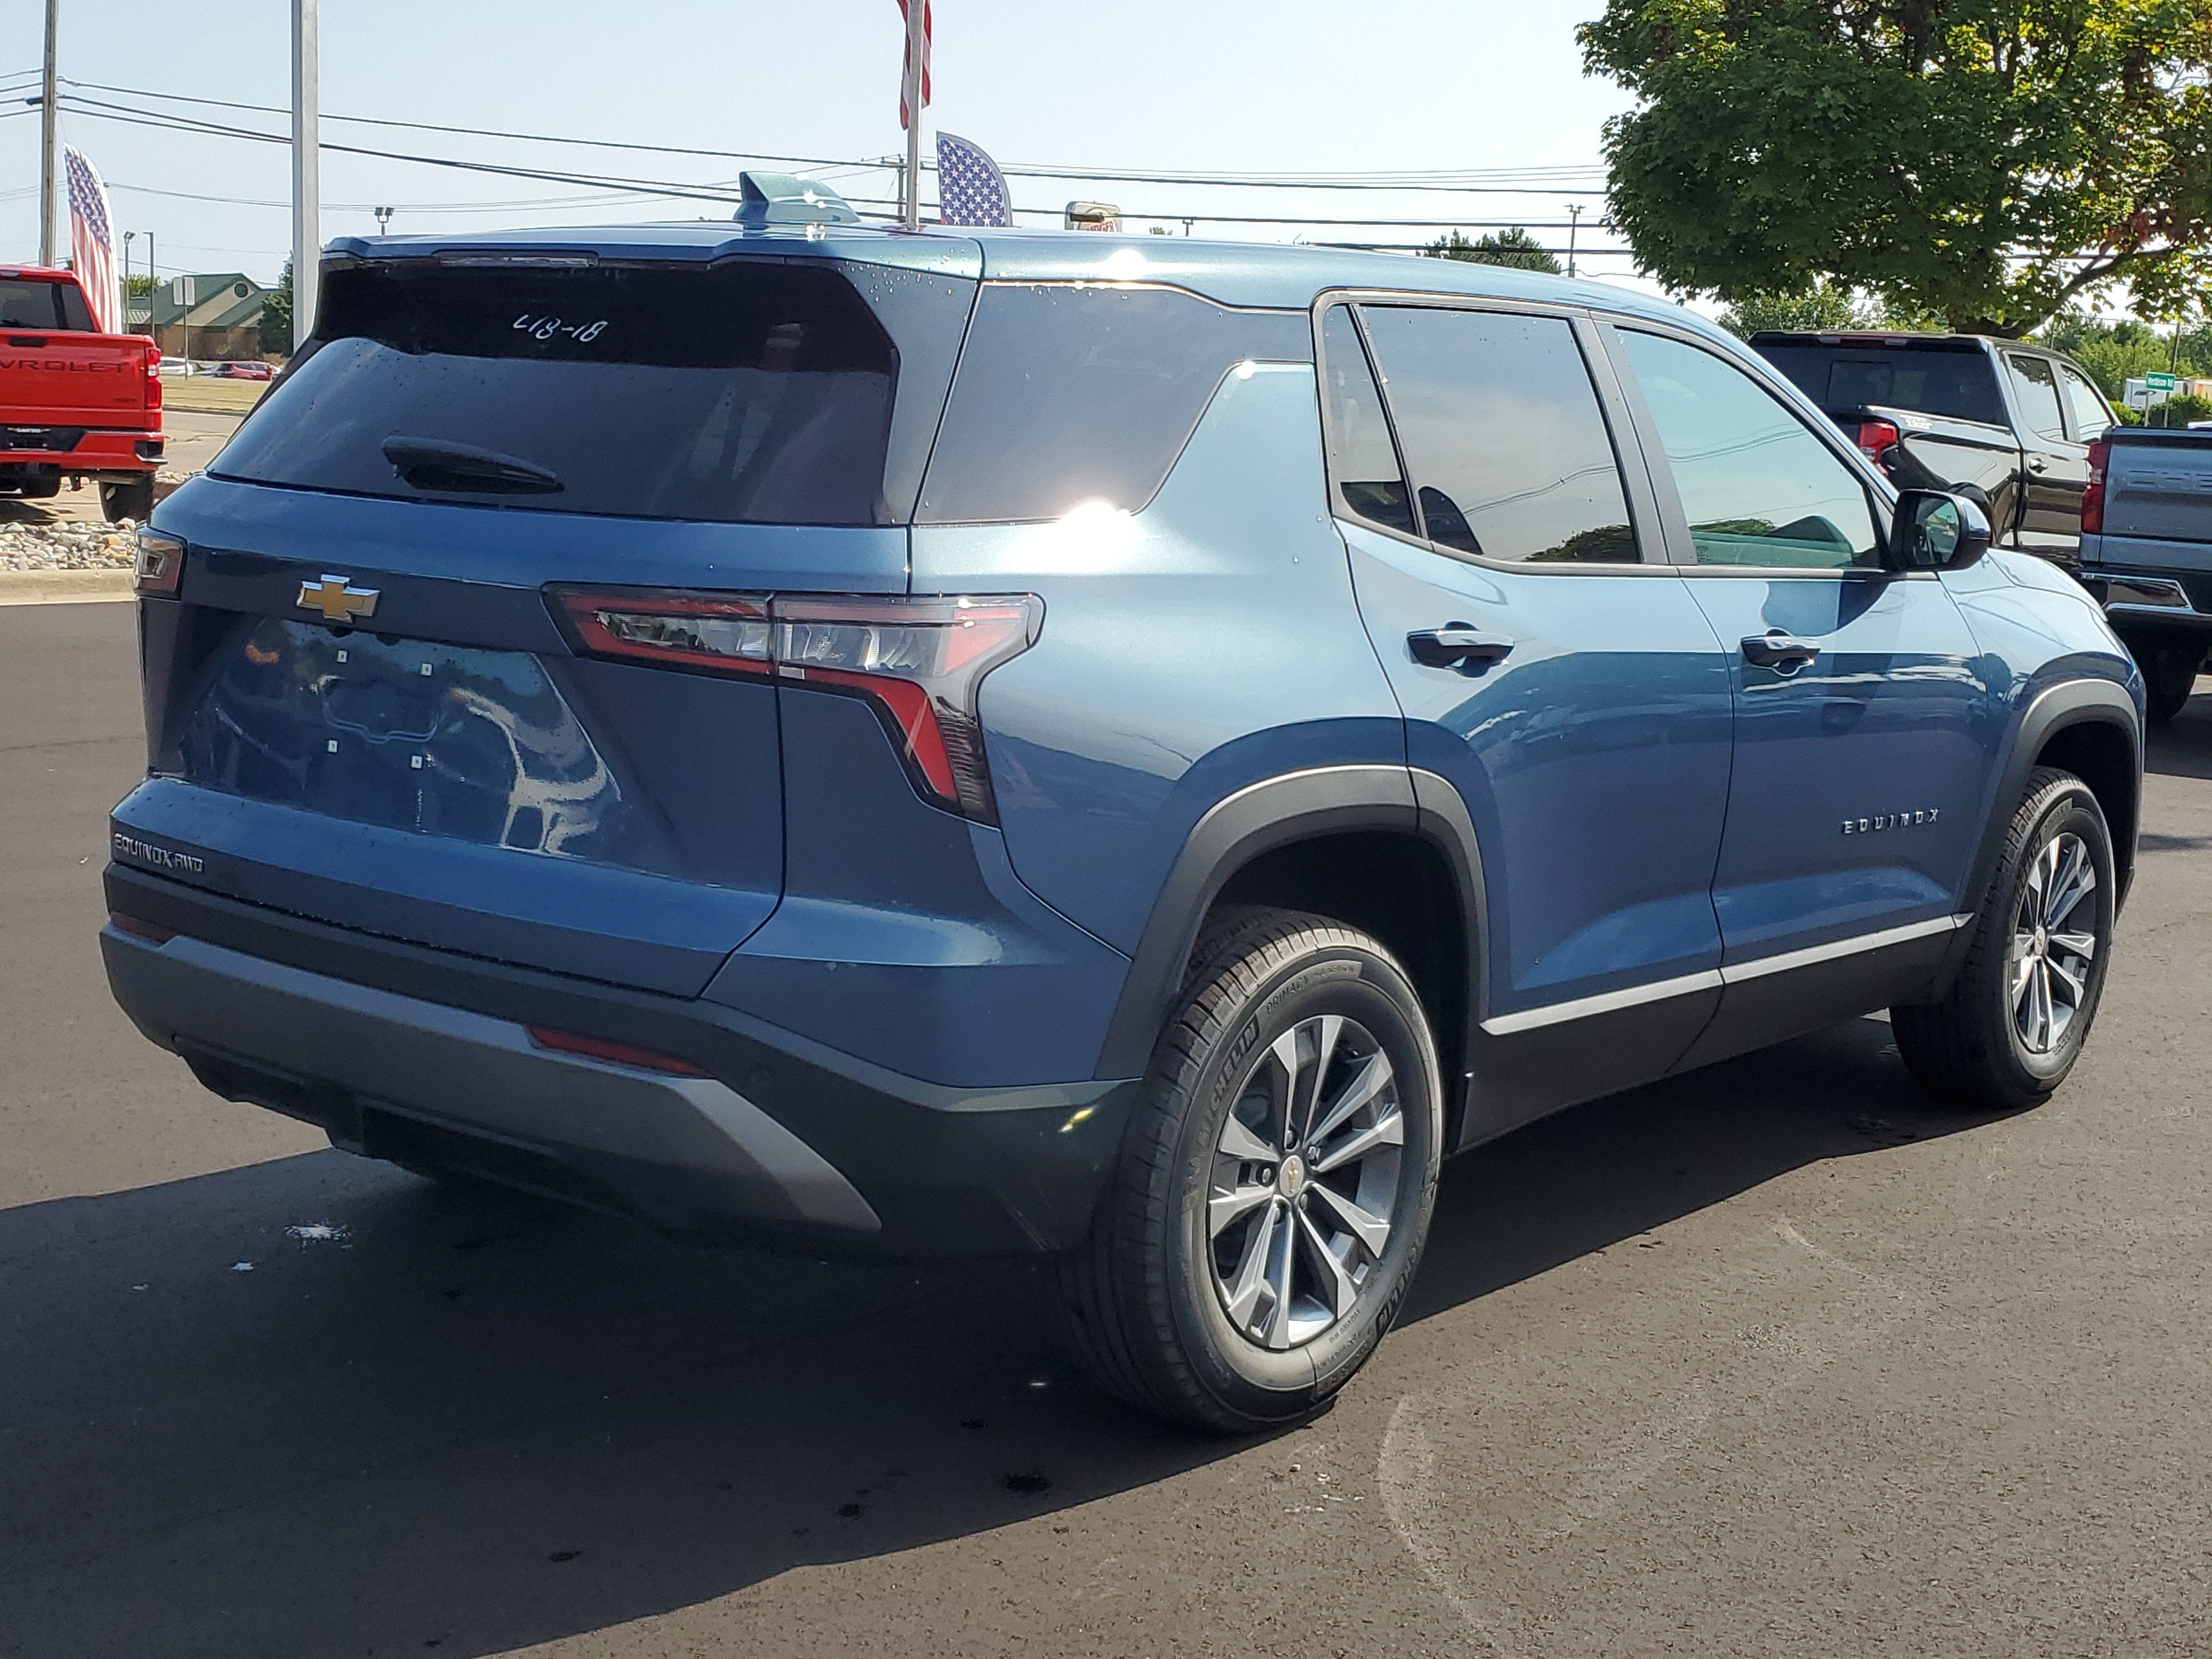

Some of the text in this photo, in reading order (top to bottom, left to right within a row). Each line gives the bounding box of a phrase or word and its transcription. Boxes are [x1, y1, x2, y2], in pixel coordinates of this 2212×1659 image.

[1842, 808, 1939, 834] EQUINOX
[114, 832, 204, 872] EQUINOX AWD
[1197, 1018, 1259, 1149] MICHELIN
